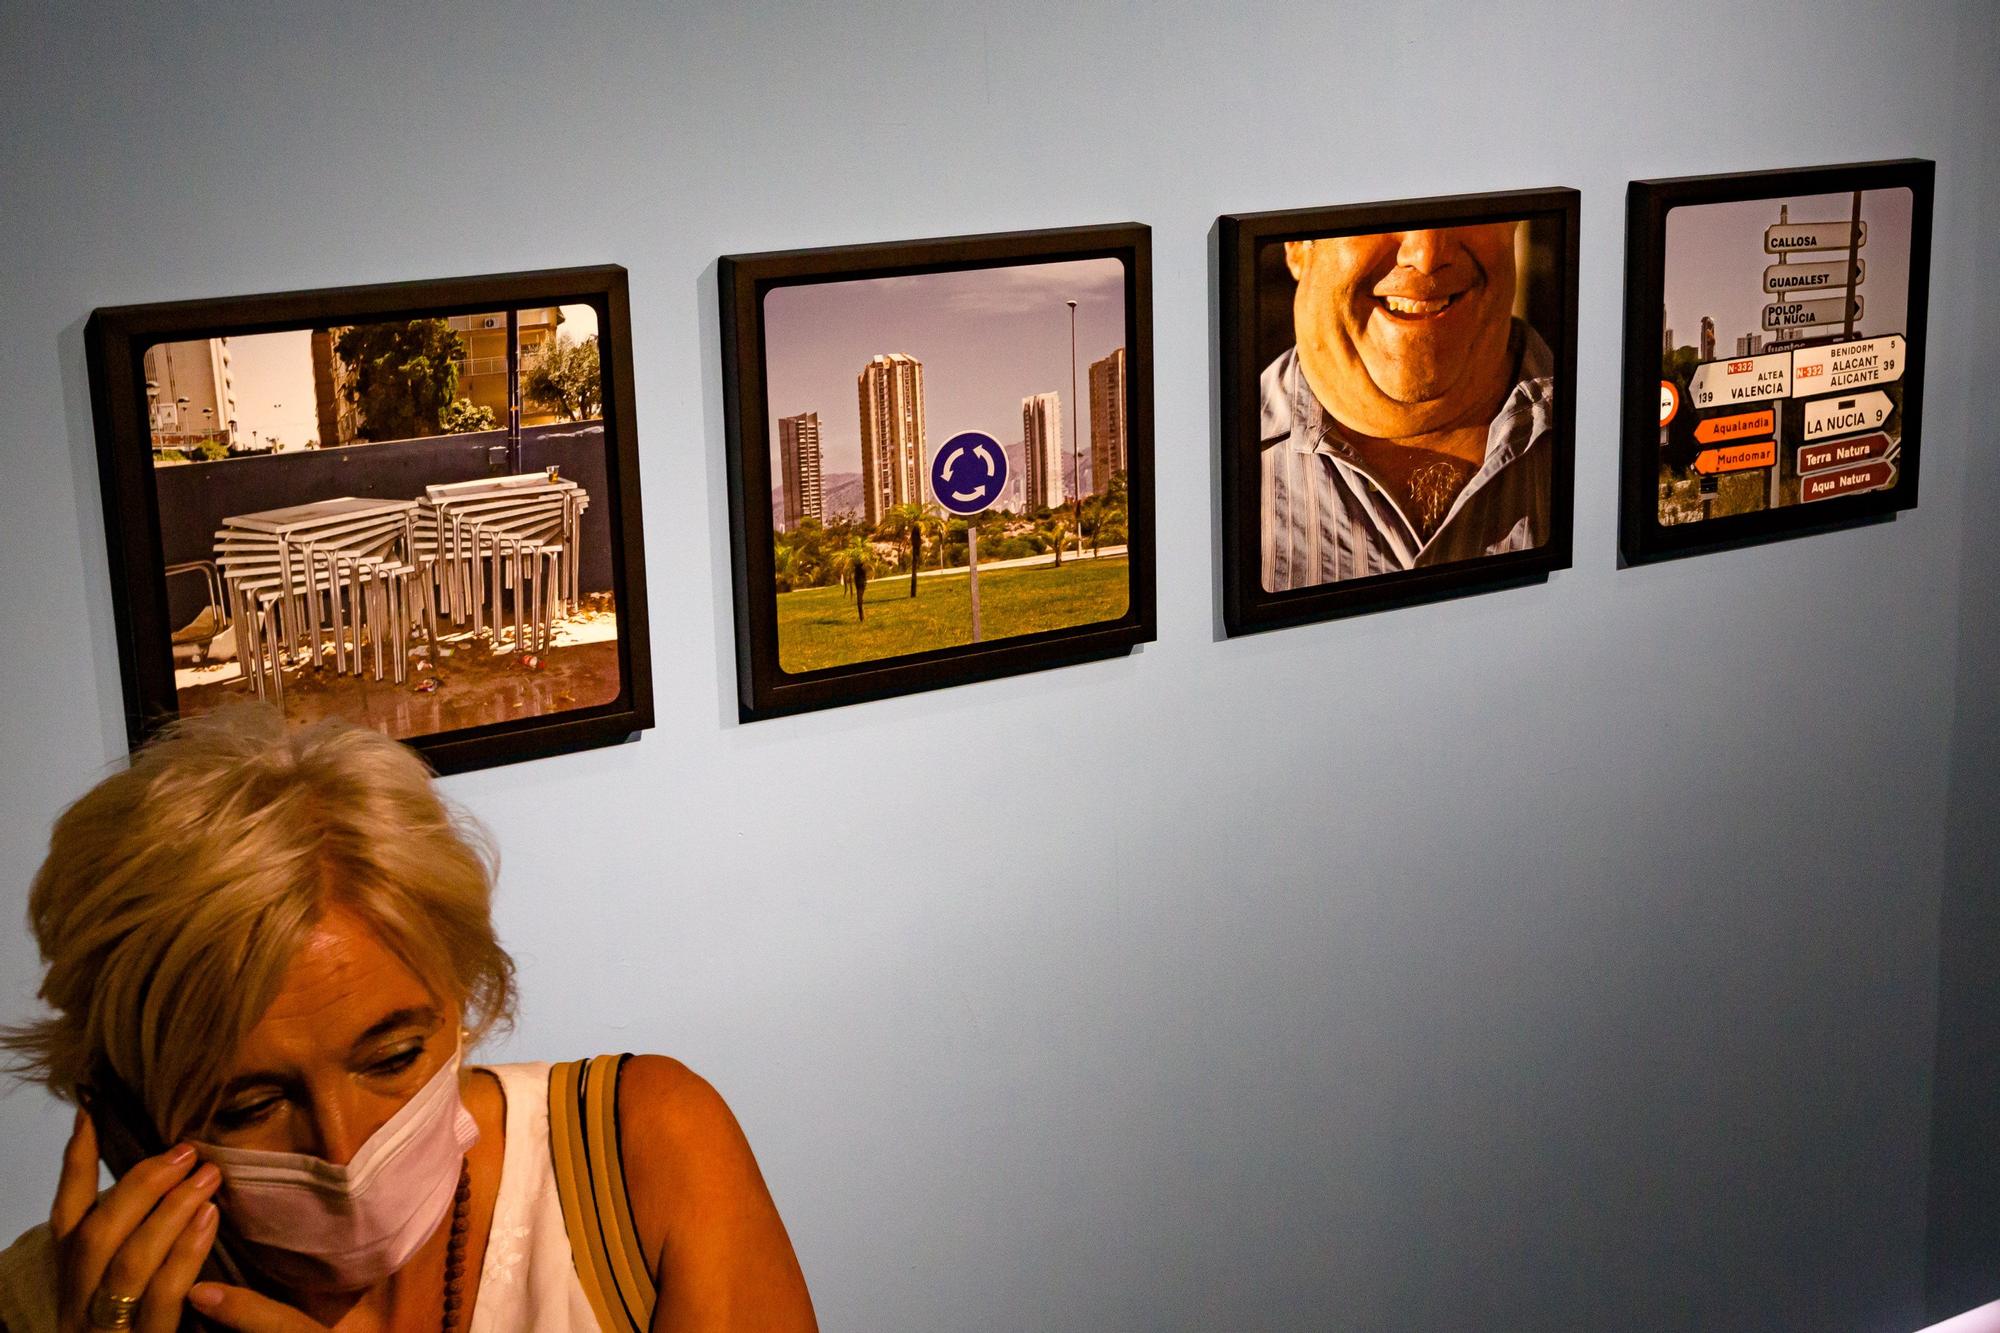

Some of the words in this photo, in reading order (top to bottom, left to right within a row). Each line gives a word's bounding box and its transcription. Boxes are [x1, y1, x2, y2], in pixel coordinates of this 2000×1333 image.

[1771, 236, 1817, 248] CALLOSA
[1769, 274, 1830, 288] GUADALEST
[1768, 304, 1803, 316] POLOP
[1768, 316, 1780, 326] LA
[1784, 312, 1816, 324] NUCIA
[1831, 344, 1874, 358] BENIDORM
[1890, 340, 1895, 349] 5
[1728, 362, 1753, 374] N-332
[1796, 365, 1823, 378] N-332
[1832, 355, 1878, 372] ALACANT
[1883, 360, 1895, 371] 39
[1758, 370, 1784, 381] ALTEA
[1830, 370, 1879, 387] ALICANTE
[1699, 392, 1713, 404] 139
[1731, 382, 1783, 399] VALENCIA
[1713, 418, 1769, 435] Aqualandia
[1807, 420, 1823, 434] LA
[1827, 412, 1865, 431] NUCIA
[1876, 409, 1883, 421] 9
[1717, 450, 1771, 465] Mundomar
[1806, 453, 1831, 466] Terra
[1836, 445, 1870, 460] Natura
[1811, 480, 1835, 493] Aqua
[1839, 473, 1870, 487] Natura
